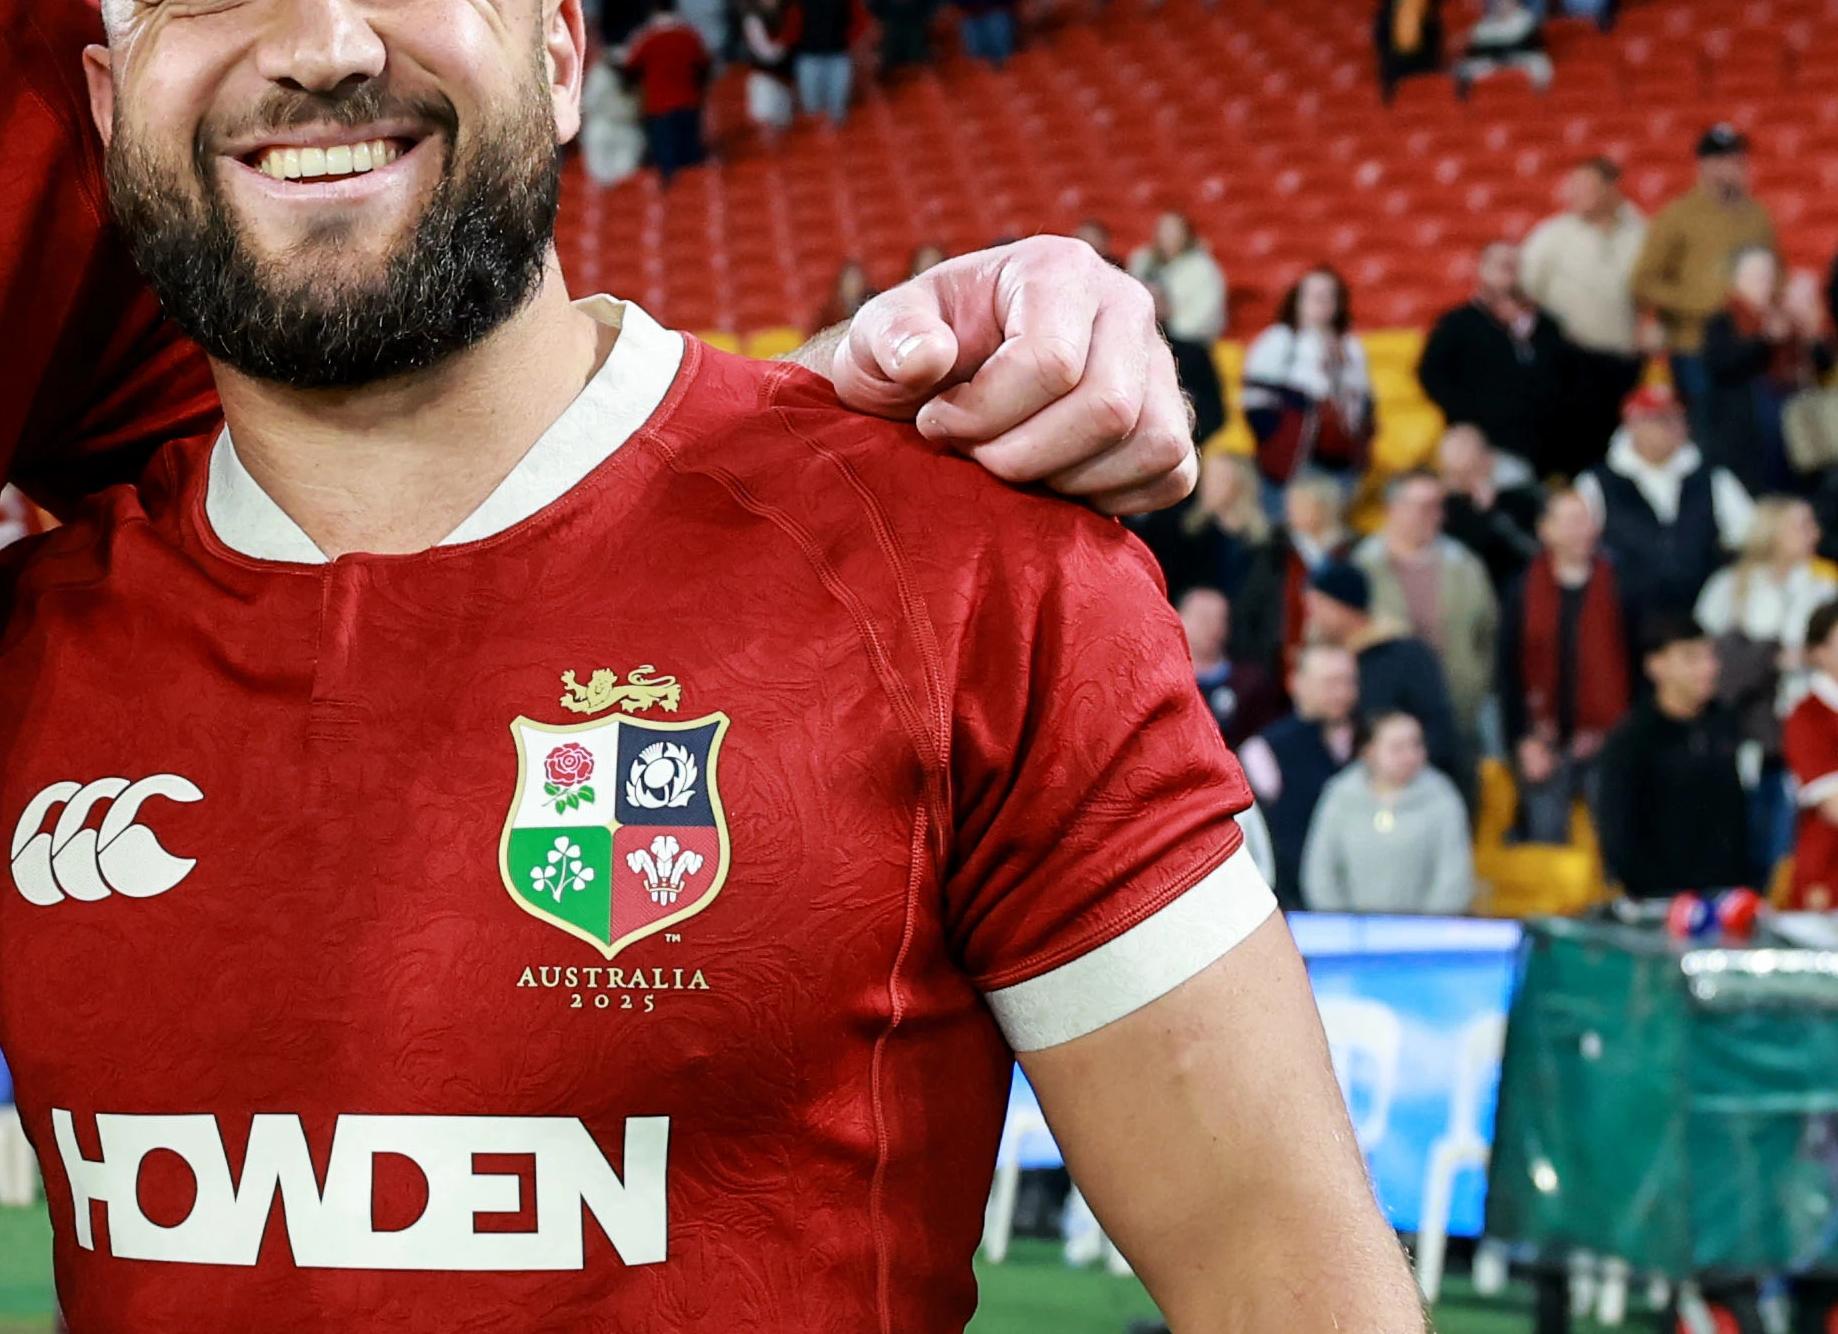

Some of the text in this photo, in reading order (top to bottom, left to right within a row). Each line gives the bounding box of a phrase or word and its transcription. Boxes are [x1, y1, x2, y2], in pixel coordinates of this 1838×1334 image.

[665, 933, 681, 942] TM
[516, 966, 710, 989] AUSTRALIA
[570, 994, 655, 1012] 2025
[51, 1108, 670, 1271] HOWDEN
